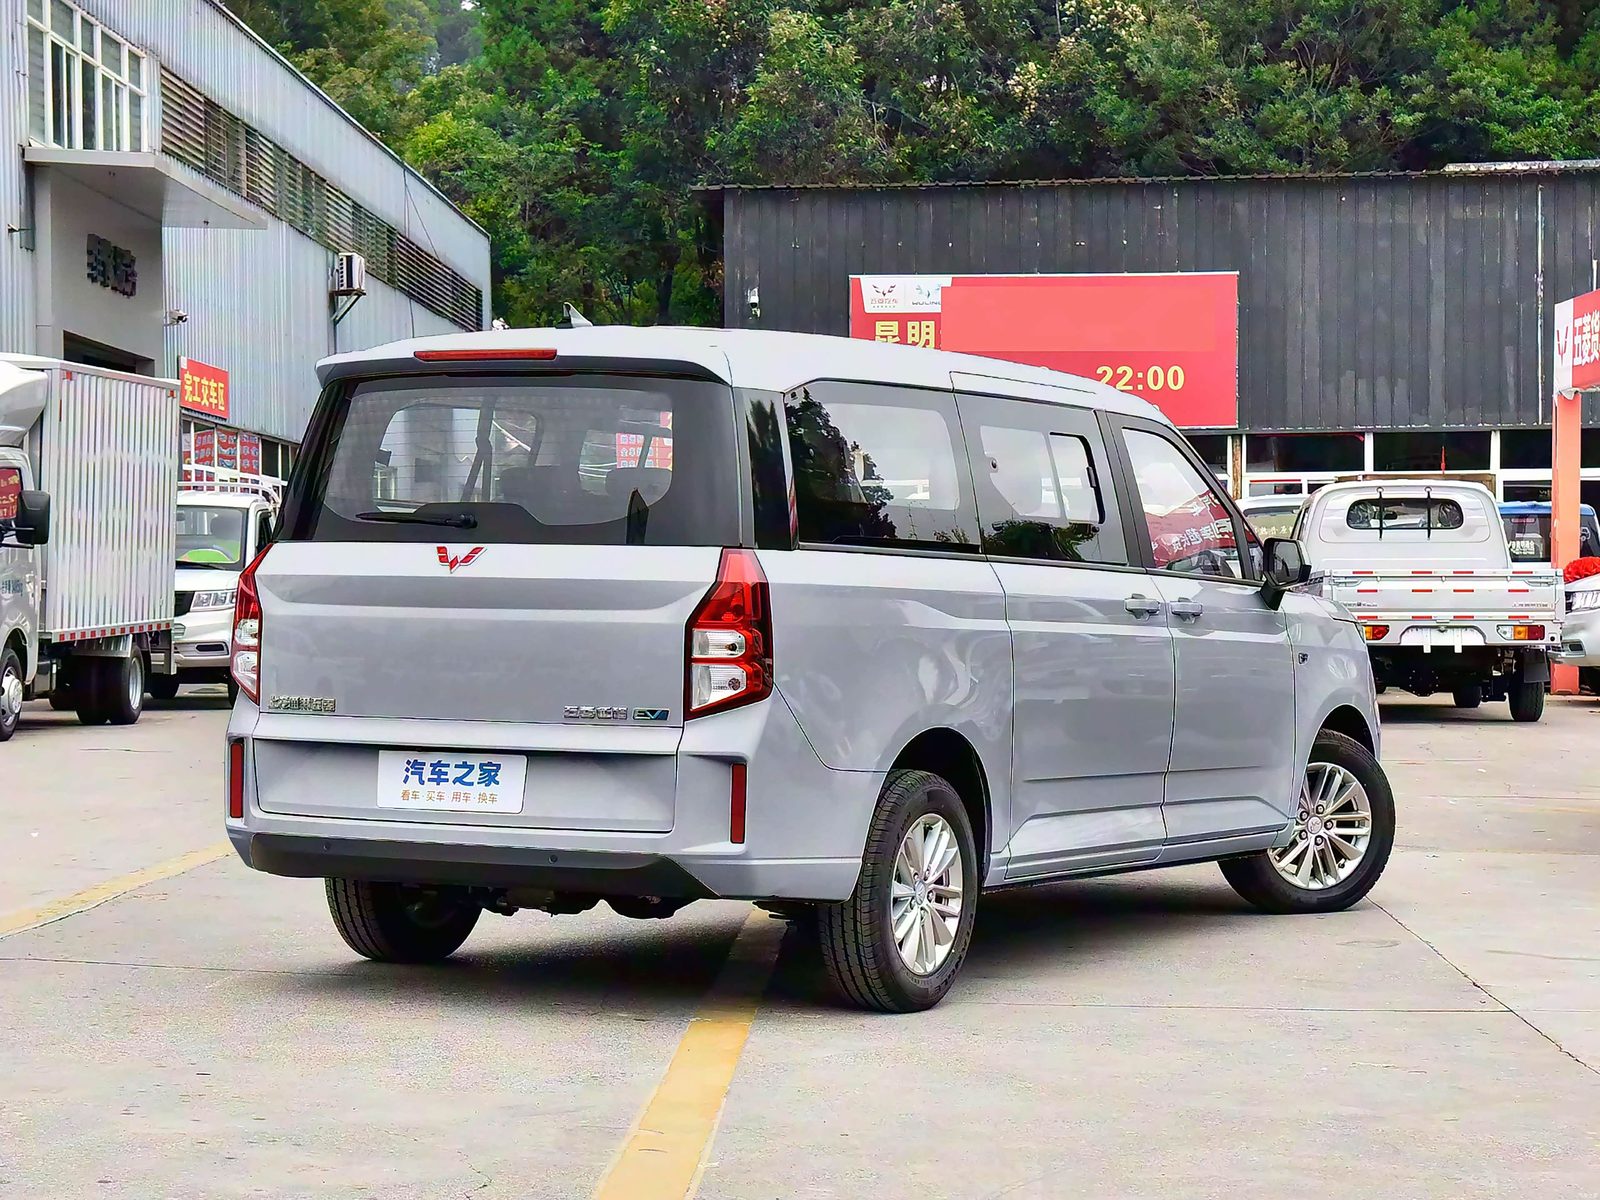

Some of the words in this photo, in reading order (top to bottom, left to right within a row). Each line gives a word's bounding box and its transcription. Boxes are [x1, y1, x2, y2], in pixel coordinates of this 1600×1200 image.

[1096, 366, 1185, 391] 22:00
[402, 759, 502, 787] 汽车之家
